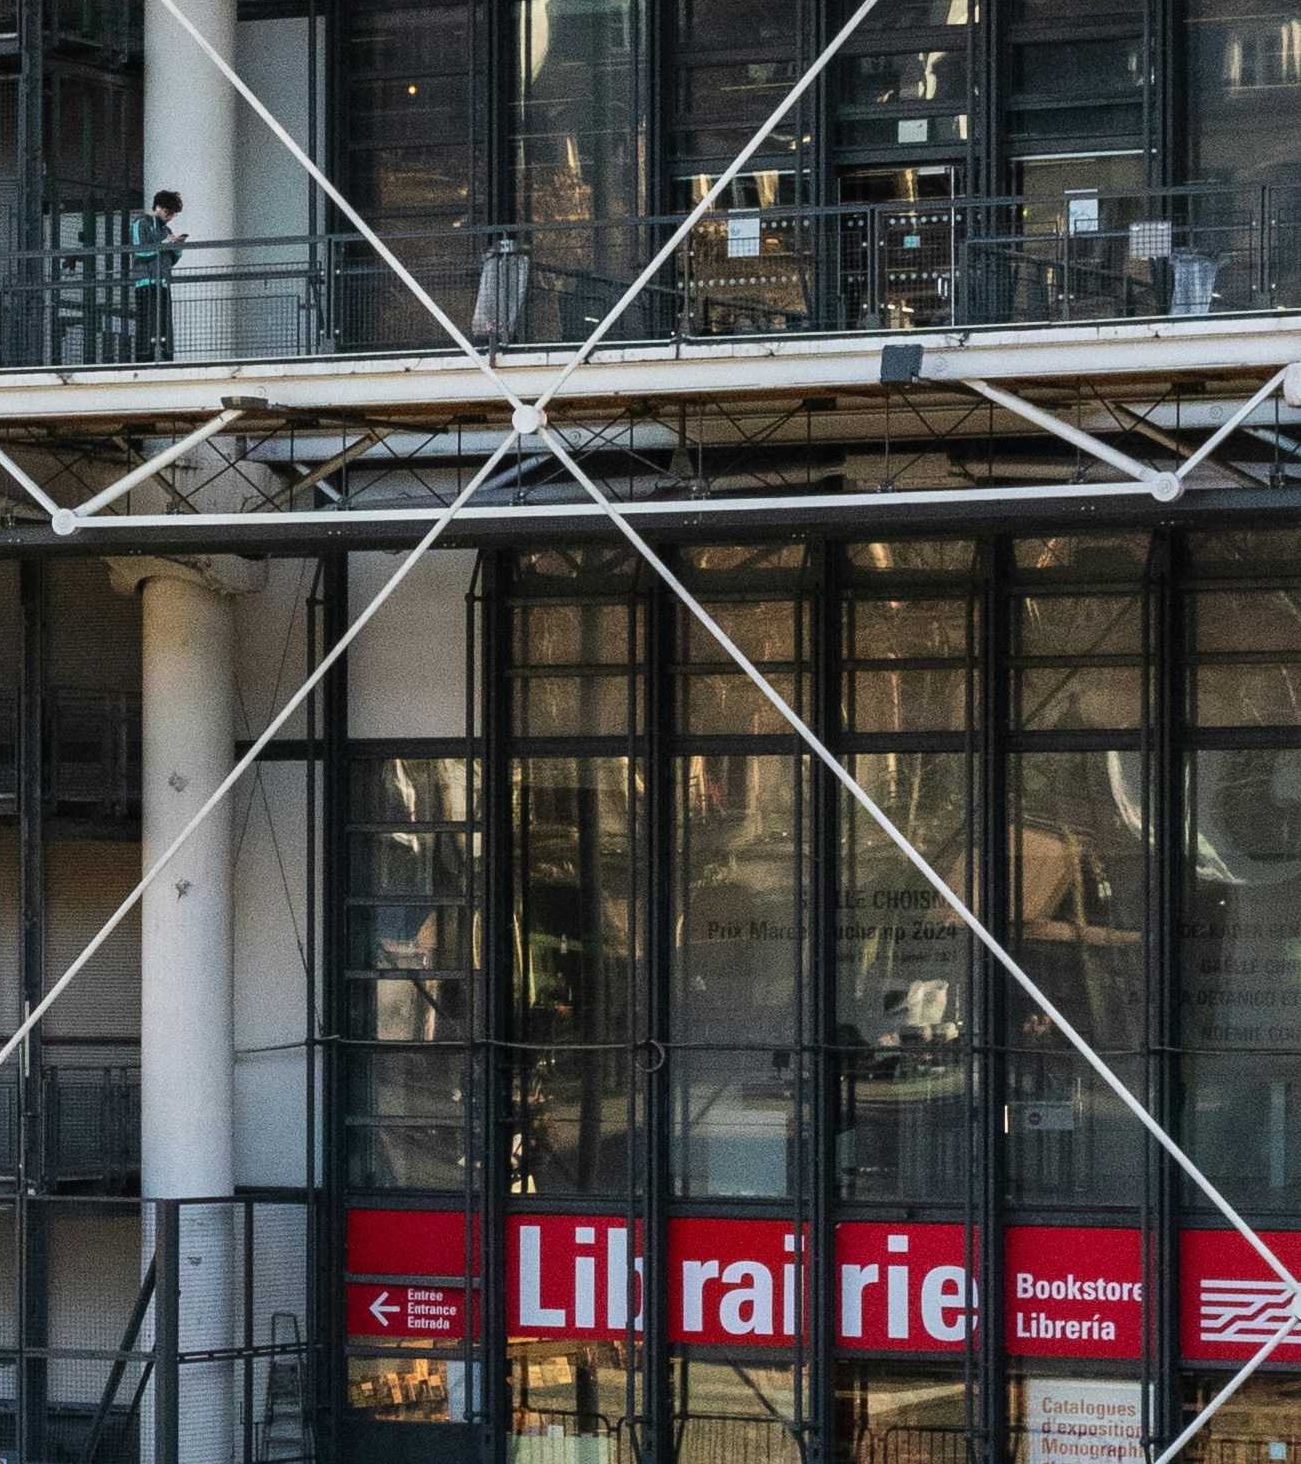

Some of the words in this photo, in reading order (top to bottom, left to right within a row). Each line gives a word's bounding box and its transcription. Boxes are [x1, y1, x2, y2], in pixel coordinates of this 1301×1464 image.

[912, 920, 958, 940] 2024
[519, 1226, 979, 1341] Librairie
[1016, 1272, 1142, 1302] Bookstore
[407, 1302, 457, 1316] Entrance
[407, 1316, 450, 1330] Entrada
[1016, 1312, 1116, 1340] Librería
[1042, 1396, 1136, 1420] Catalogues
